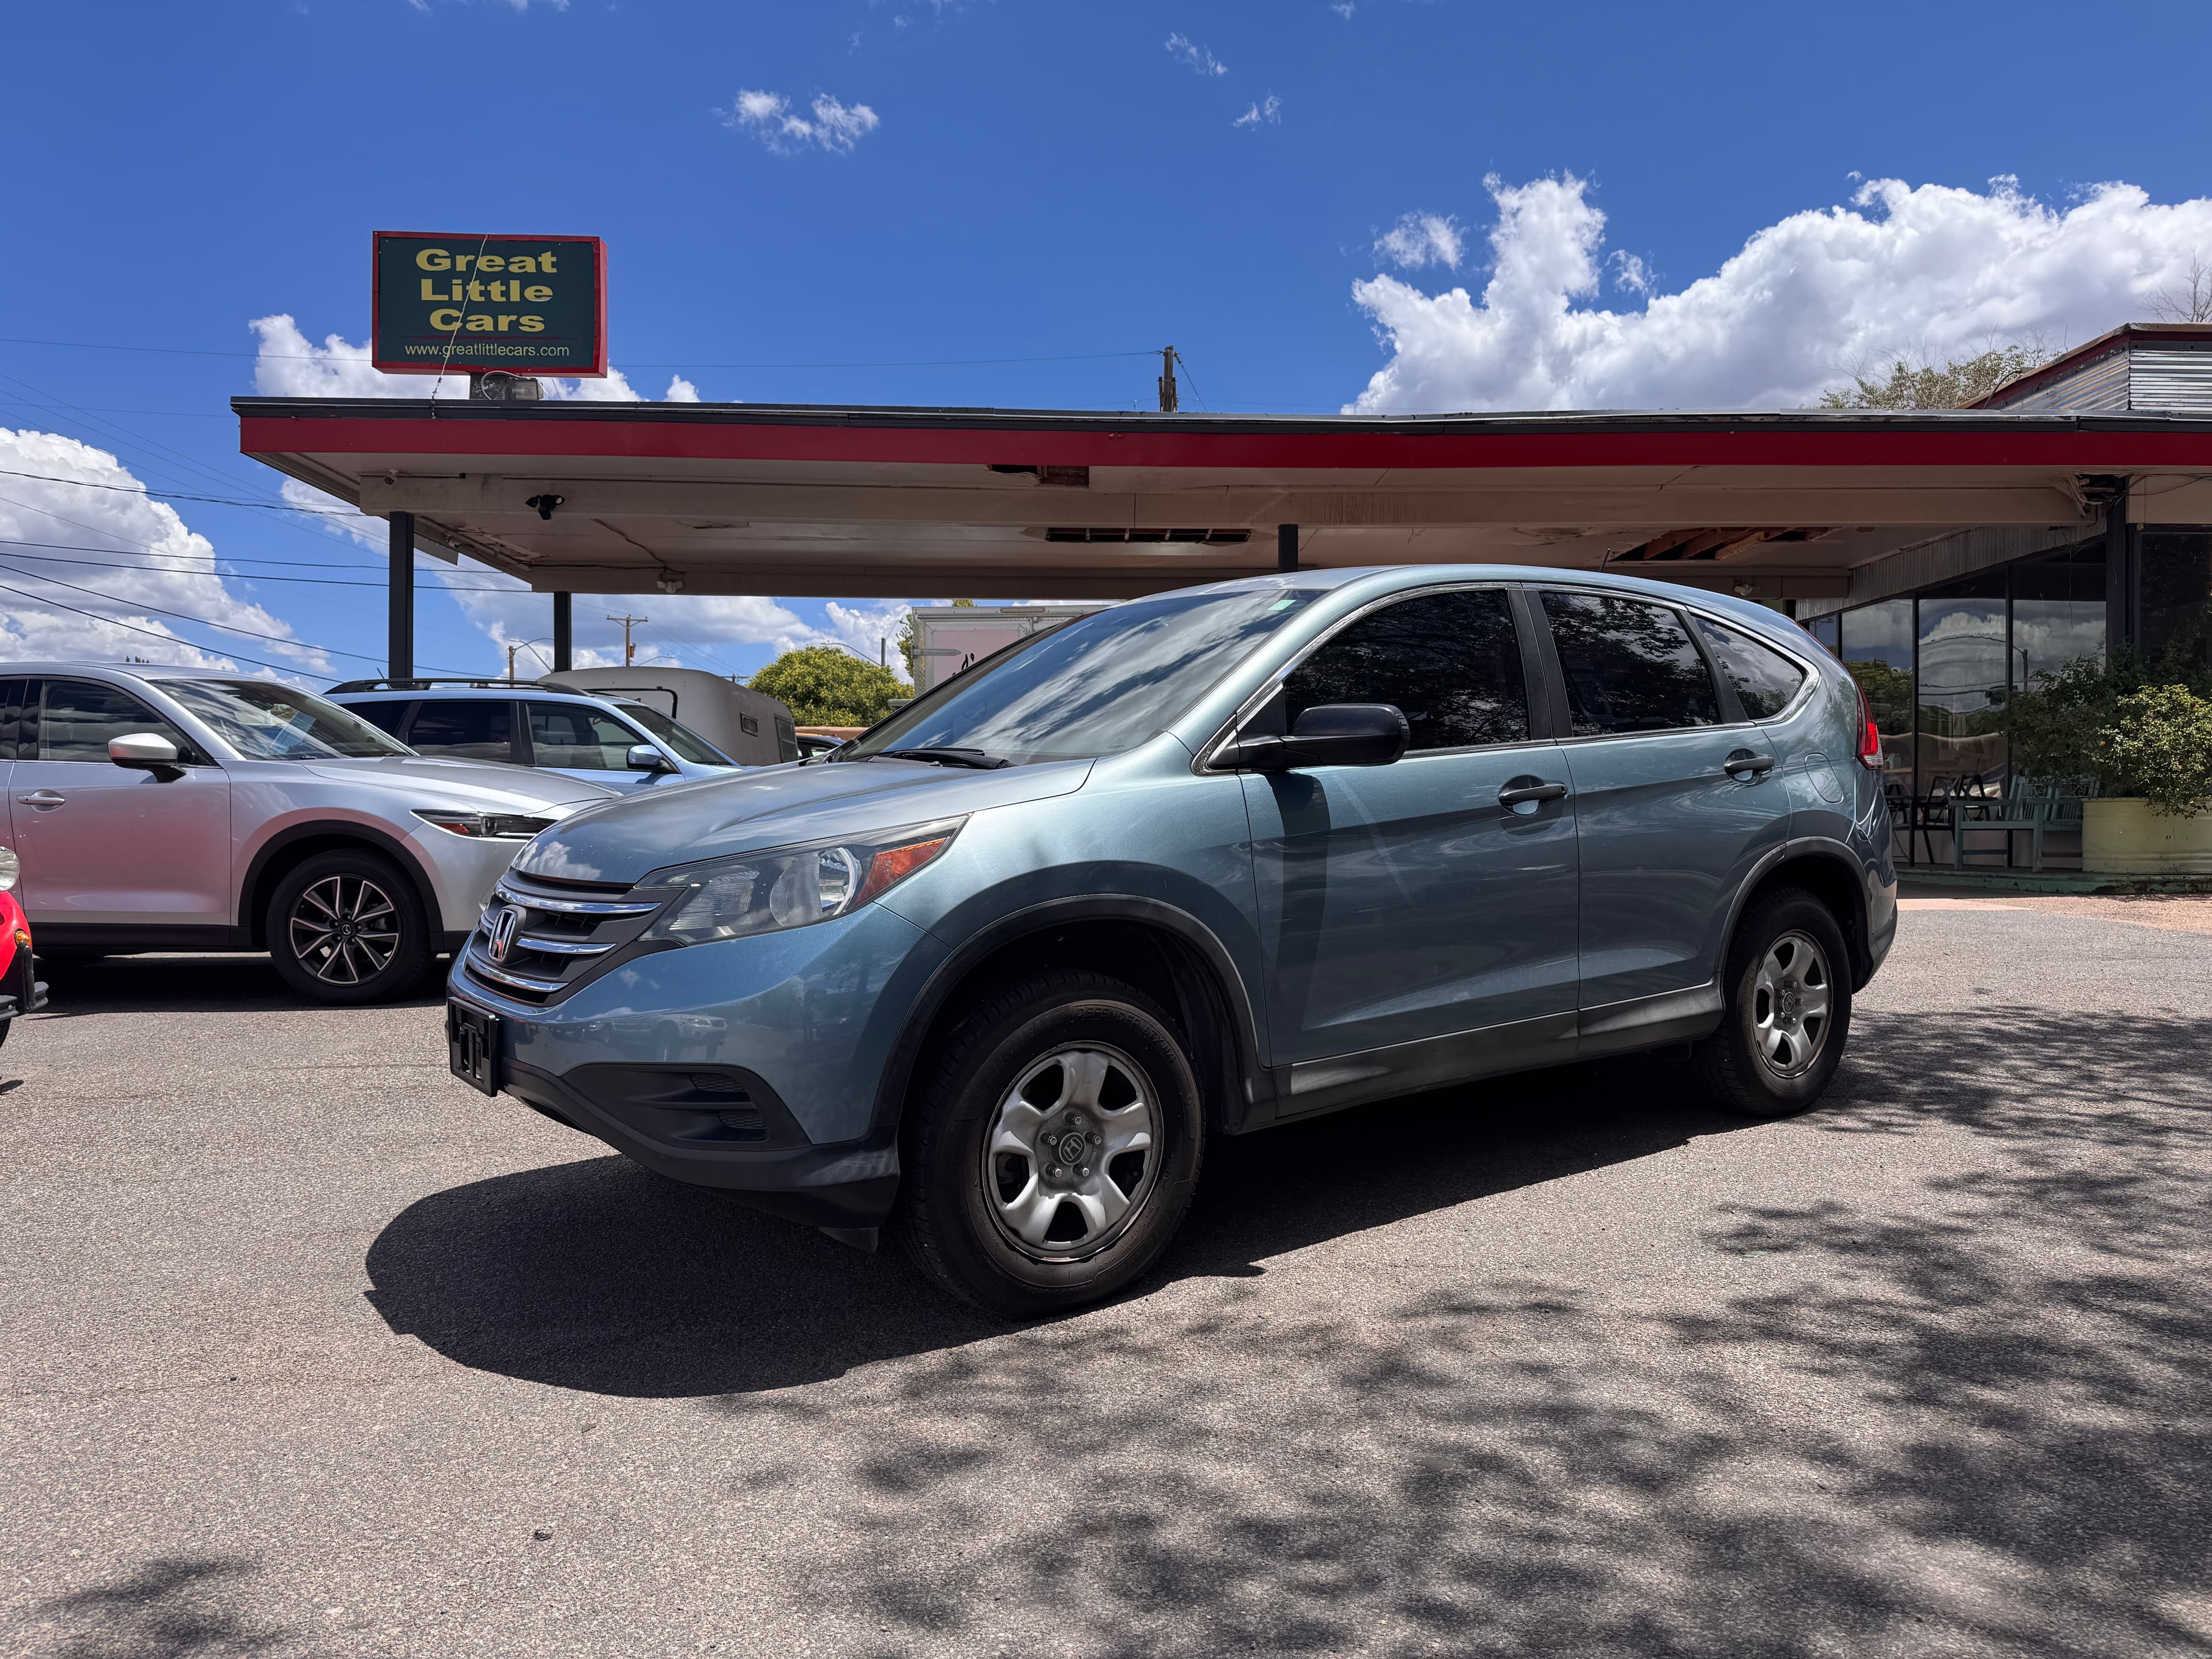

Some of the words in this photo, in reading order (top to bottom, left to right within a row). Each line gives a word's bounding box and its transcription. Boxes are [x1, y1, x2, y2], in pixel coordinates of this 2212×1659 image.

[415, 248, 558, 274] Great
[421, 278, 554, 302] Little
[429, 308, 546, 332] Cars
[404, 343, 570, 358] www.greatlittlecars.com
